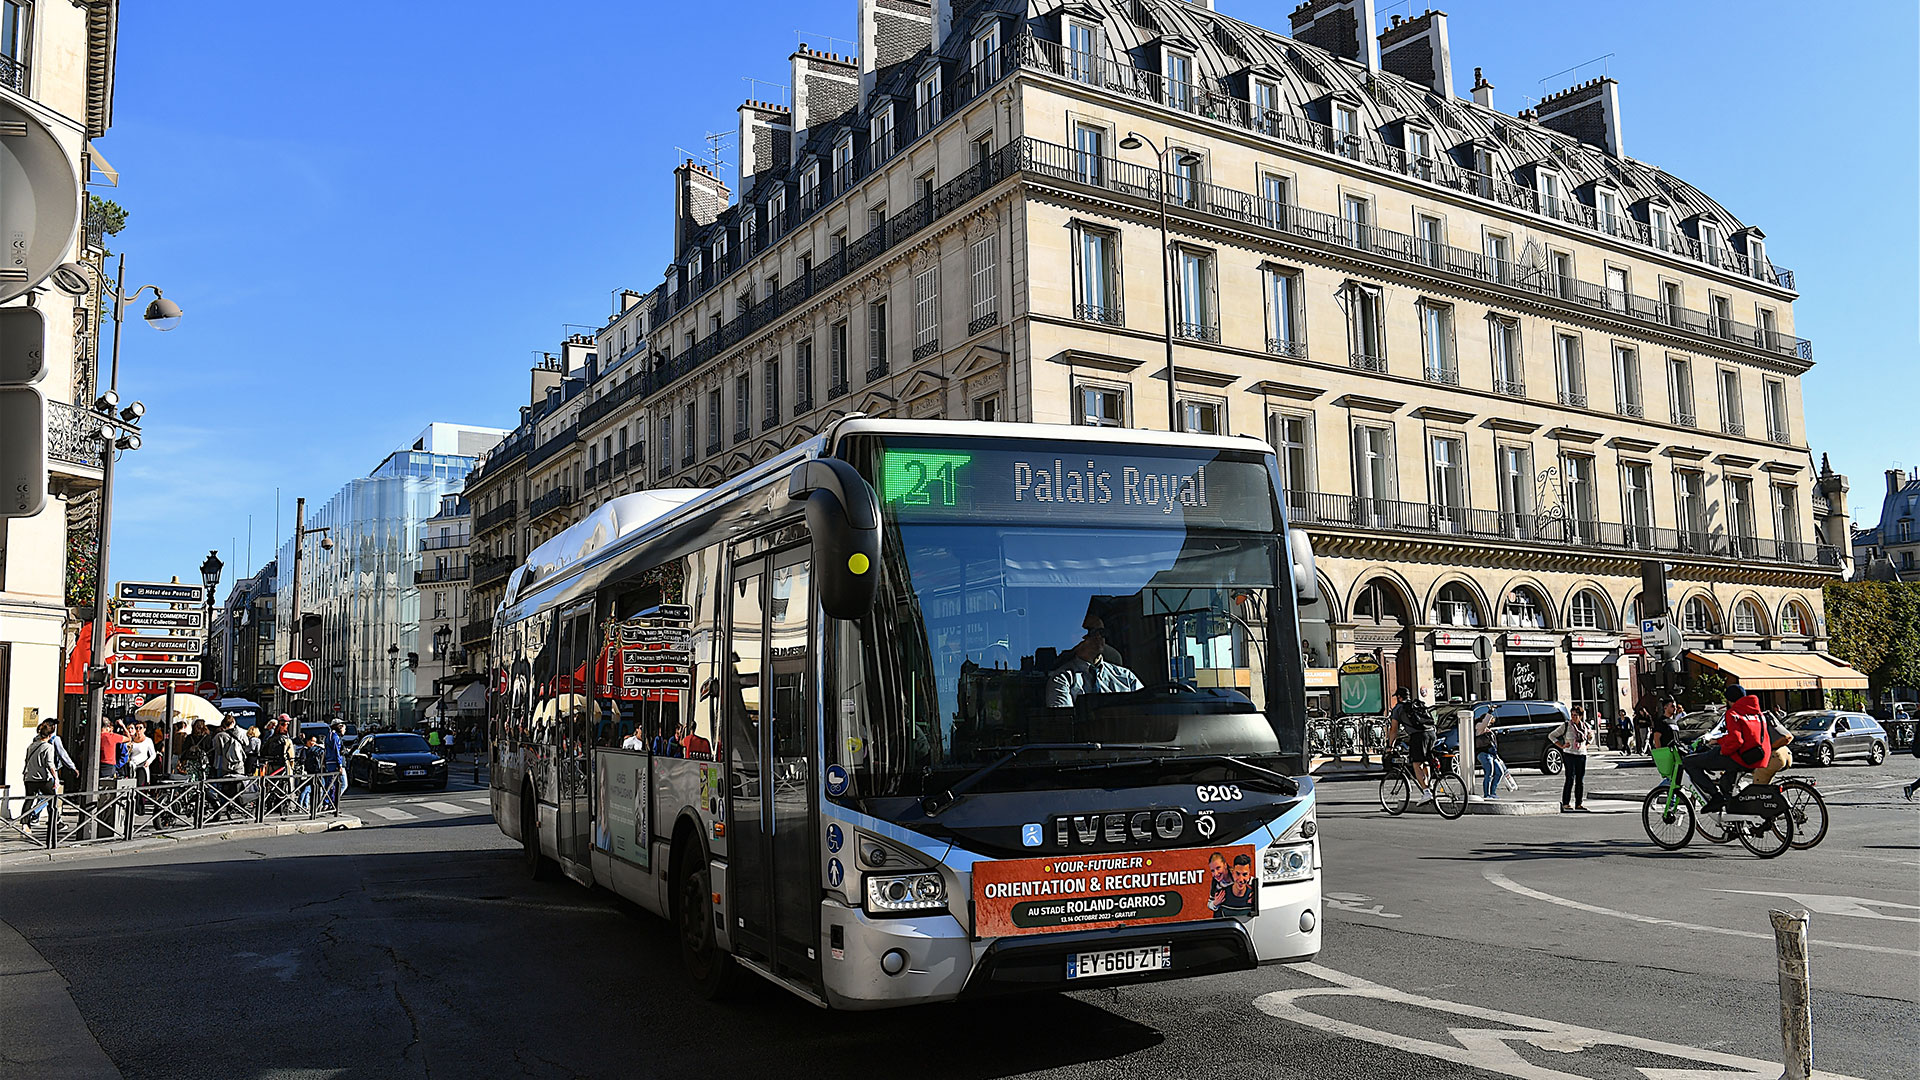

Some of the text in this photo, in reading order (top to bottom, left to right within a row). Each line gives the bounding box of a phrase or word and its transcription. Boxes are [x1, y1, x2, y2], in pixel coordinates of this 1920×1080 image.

[903, 459, 956, 506] 21
[1013, 459, 1208, 514] Palais Royal
[172, 589, 191, 597] Postes
[1645, 623, 1652, 631] P
[131, 666, 150, 674] Forum
[106, 680, 166, 690] UGUSTE
[1196, 785, 1243, 803] 6203
[1056, 810, 1184, 847] IVECO
[1053, 857, 1143, 873] YOUR-FUTURE.FR
[985, 869, 1205, 898] ORIENTATION & RECRUTEMENT
[1028, 894, 1166, 916] AU STADE ROLAND-GARROS
[1073, 914, 1098, 922] OCTOBRE
[1080, 948, 1159, 975] EY-660-ZT
[1162, 957, 1171, 967] 75
